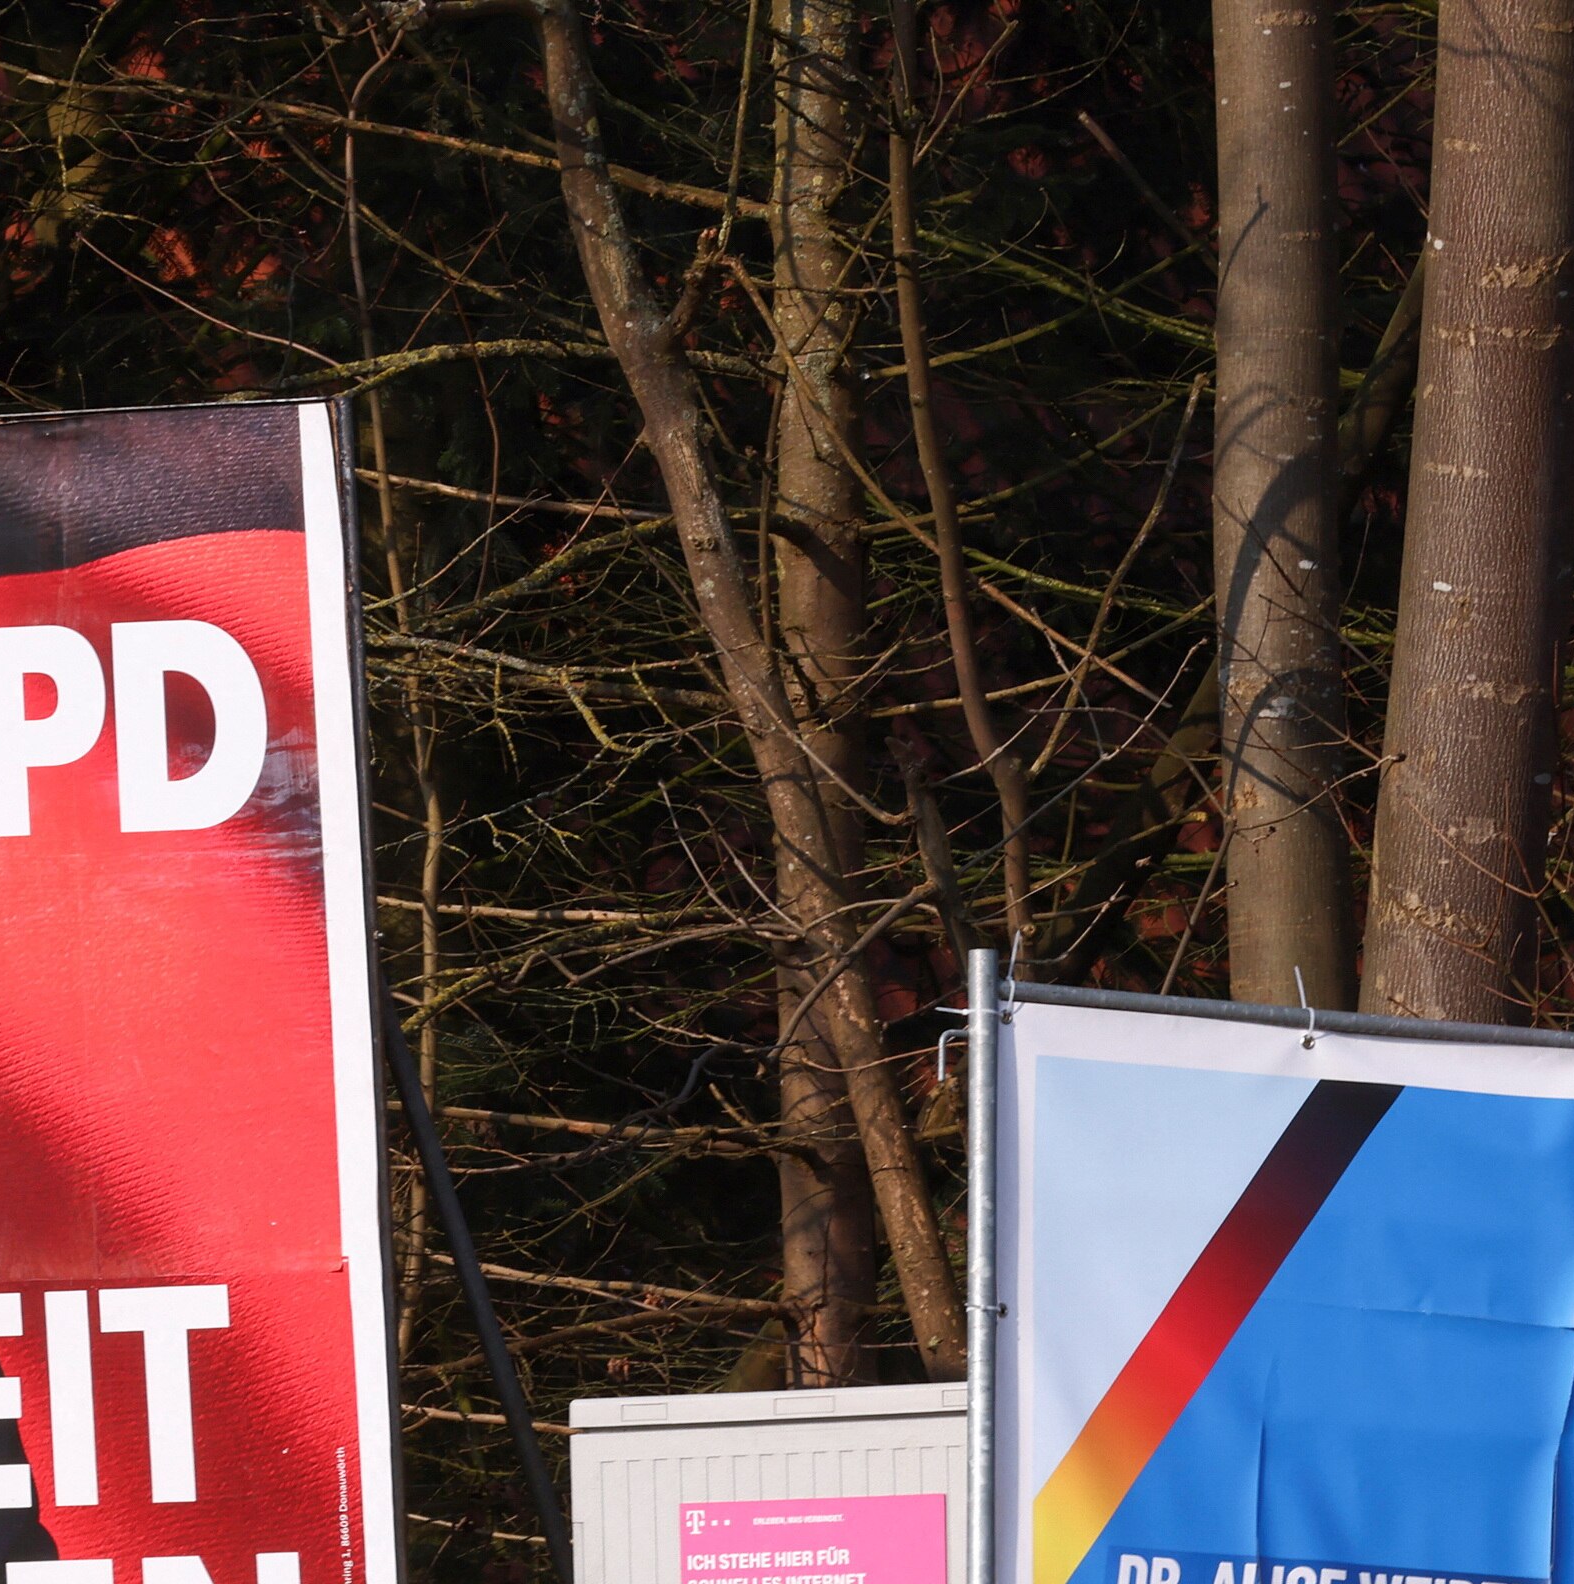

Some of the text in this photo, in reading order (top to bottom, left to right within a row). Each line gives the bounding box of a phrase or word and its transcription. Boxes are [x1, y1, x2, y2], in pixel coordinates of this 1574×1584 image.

[335, 1446, 349, 1513] Donauwörth
[339, 1514, 351, 1547] 86609
[340, 1549, 352, 1559] 1,
[687, 1546, 850, 1571] ICH STEHE HIER FÜR
